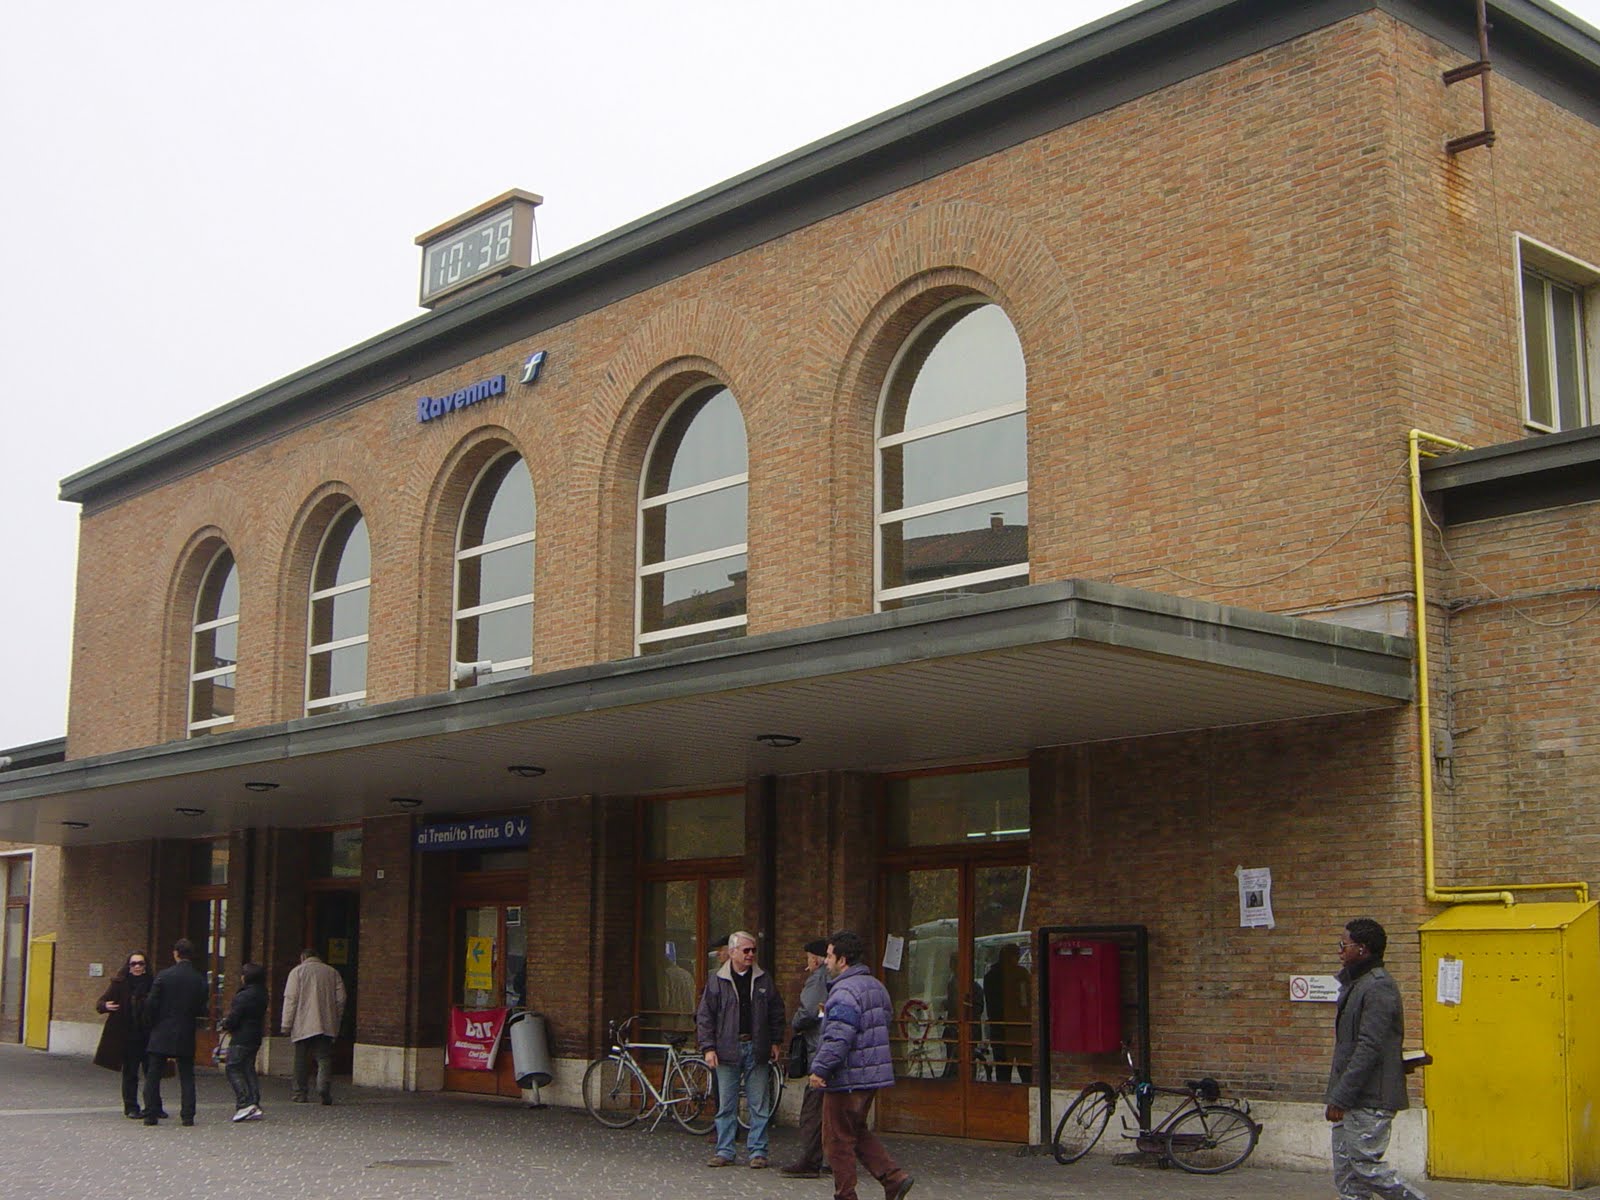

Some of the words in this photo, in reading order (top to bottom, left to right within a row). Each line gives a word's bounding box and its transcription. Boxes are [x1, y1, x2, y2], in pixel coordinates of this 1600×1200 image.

[440, 219, 512, 285] 10:38
[416, 374, 506, 423] Ravenna
[418, 829, 428, 844] ai
[429, 826, 467, 843] Treni/to
[469, 823, 500, 839] Trains
[465, 1017, 494, 1039] bar
